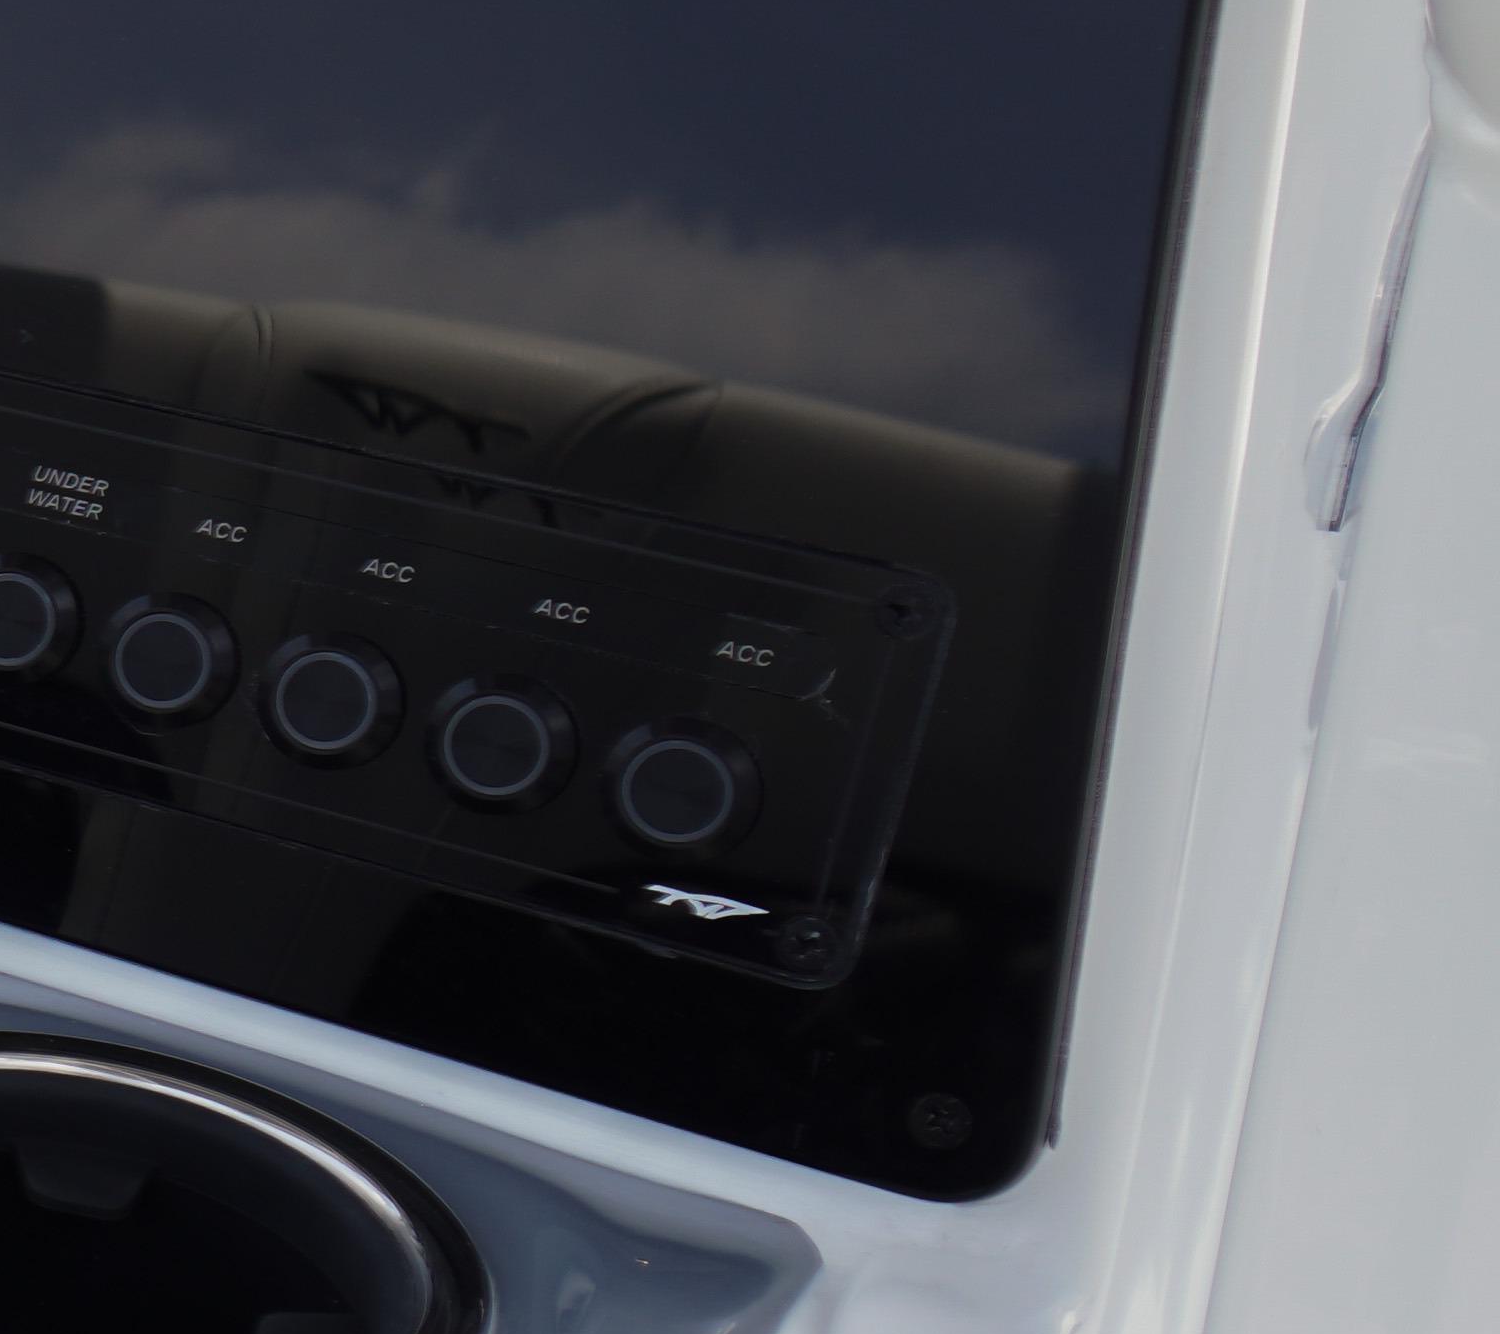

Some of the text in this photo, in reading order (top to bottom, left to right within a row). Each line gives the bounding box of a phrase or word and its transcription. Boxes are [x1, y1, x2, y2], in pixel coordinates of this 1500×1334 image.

[33, 466, 109, 497] UNDER
[27, 488, 103, 520] WATER
[197, 518, 248, 543] ACC
[363, 558, 415, 583] ACC
[534, 599, 590, 624] ACC
[716, 641, 774, 667] ACC
